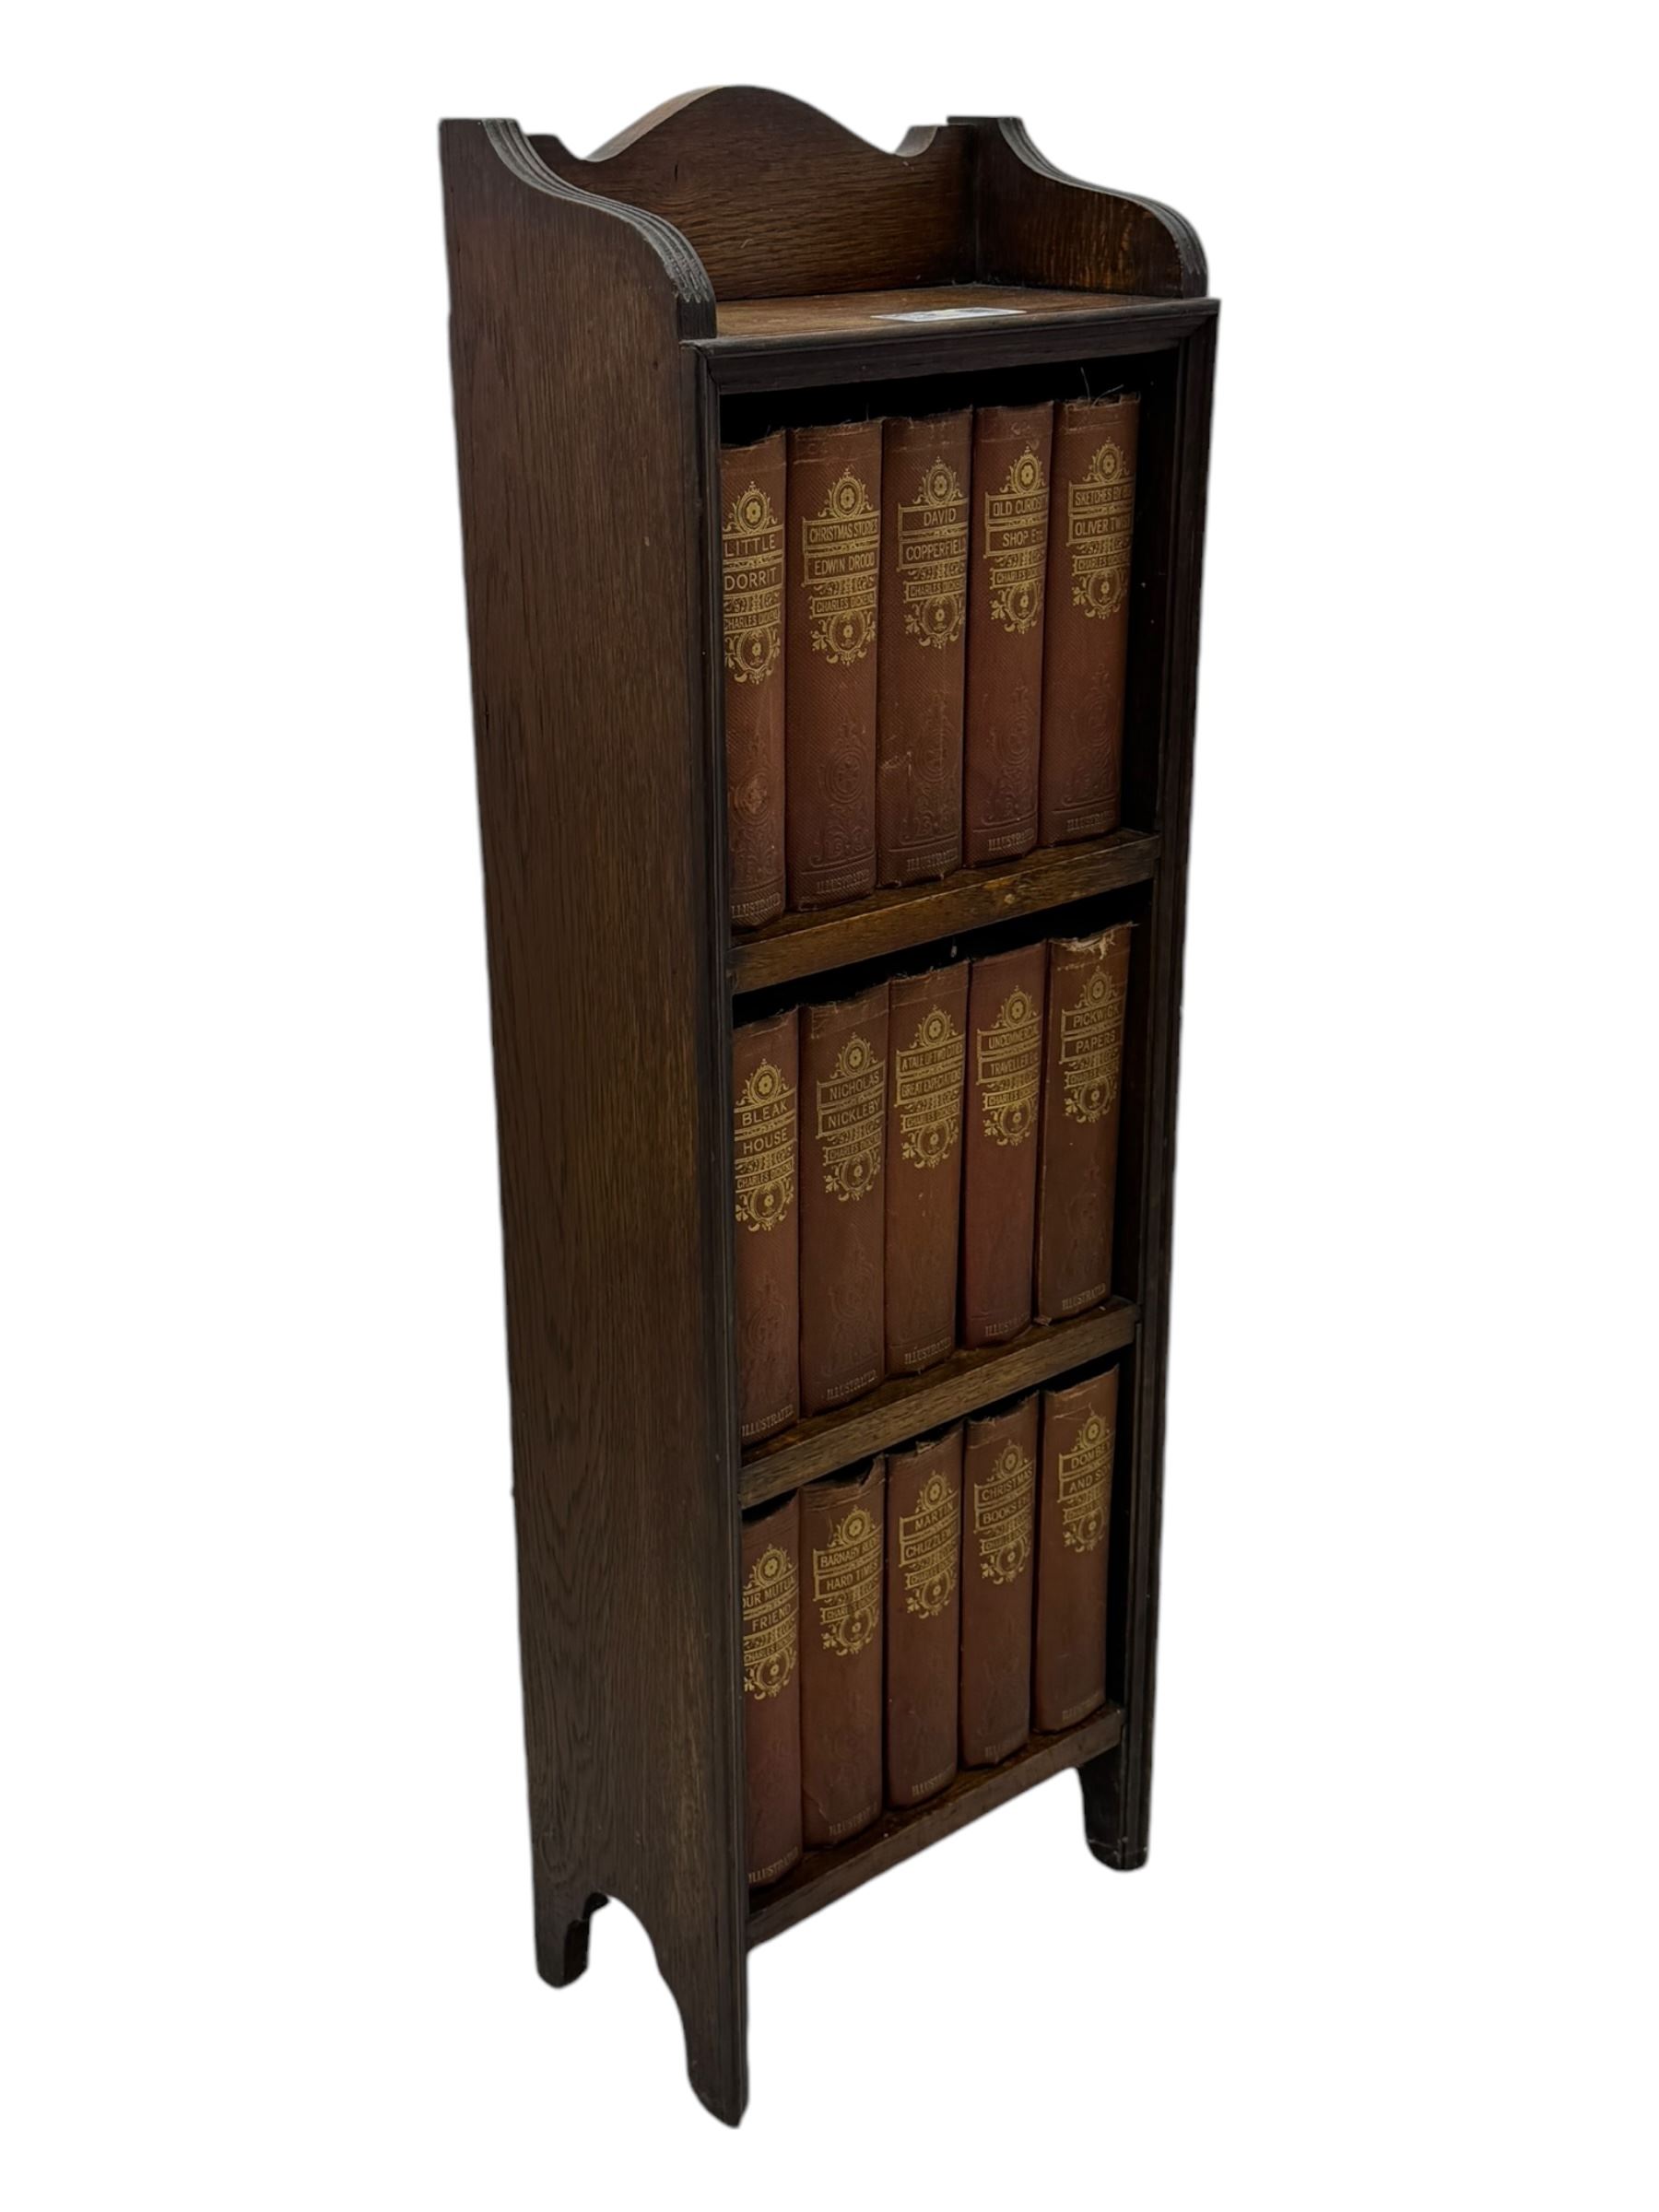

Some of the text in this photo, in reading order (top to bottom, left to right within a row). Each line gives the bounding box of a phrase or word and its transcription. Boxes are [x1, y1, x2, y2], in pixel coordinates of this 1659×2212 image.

[1076, 488, 1112, 506] SKETCHES
[924, 508, 957, 526] DAVID
[993, 501, 1013, 516] OLD
[809, 523, 853, 543] CHRISTMAS
[1076, 518, 1109, 535] OLIVER
[724, 535, 776, 558] LITTLE
[1003, 531, 1029, 547] SHOP
[814, 551, 875, 575] EDWIN DROOD
[724, 567, 776, 590] DORRIT
[817, 598, 849, 612] CHARLES
[1073, 1003, 1121, 1028] PICKWICK
[1076, 1030, 1116, 1053] PAPERS
[901, 1057, 908, 1071] A
[830, 1071, 879, 1100] NICHOLAS
[901, 1082, 922, 1098] GREAT
[742, 1100, 787, 1126] BLEAK
[828, 1097, 880, 1128] NICKLEBY
[743, 1127, 788, 1154] HOUSE
[737, 1172, 770, 1189] CHARLES
[982, 1466, 1032, 1500] CHRISTMAS
[1069, 1475, 1093, 1494] AND
[915, 1500, 954, 1531] MARTIN
[982, 1503, 1018, 1524] BOOKS
[820, 1547, 859, 1568] BARNABY
[827, 1561, 878, 1592] HARD TIMES
[752, 1604, 791, 1631] FRIEND
